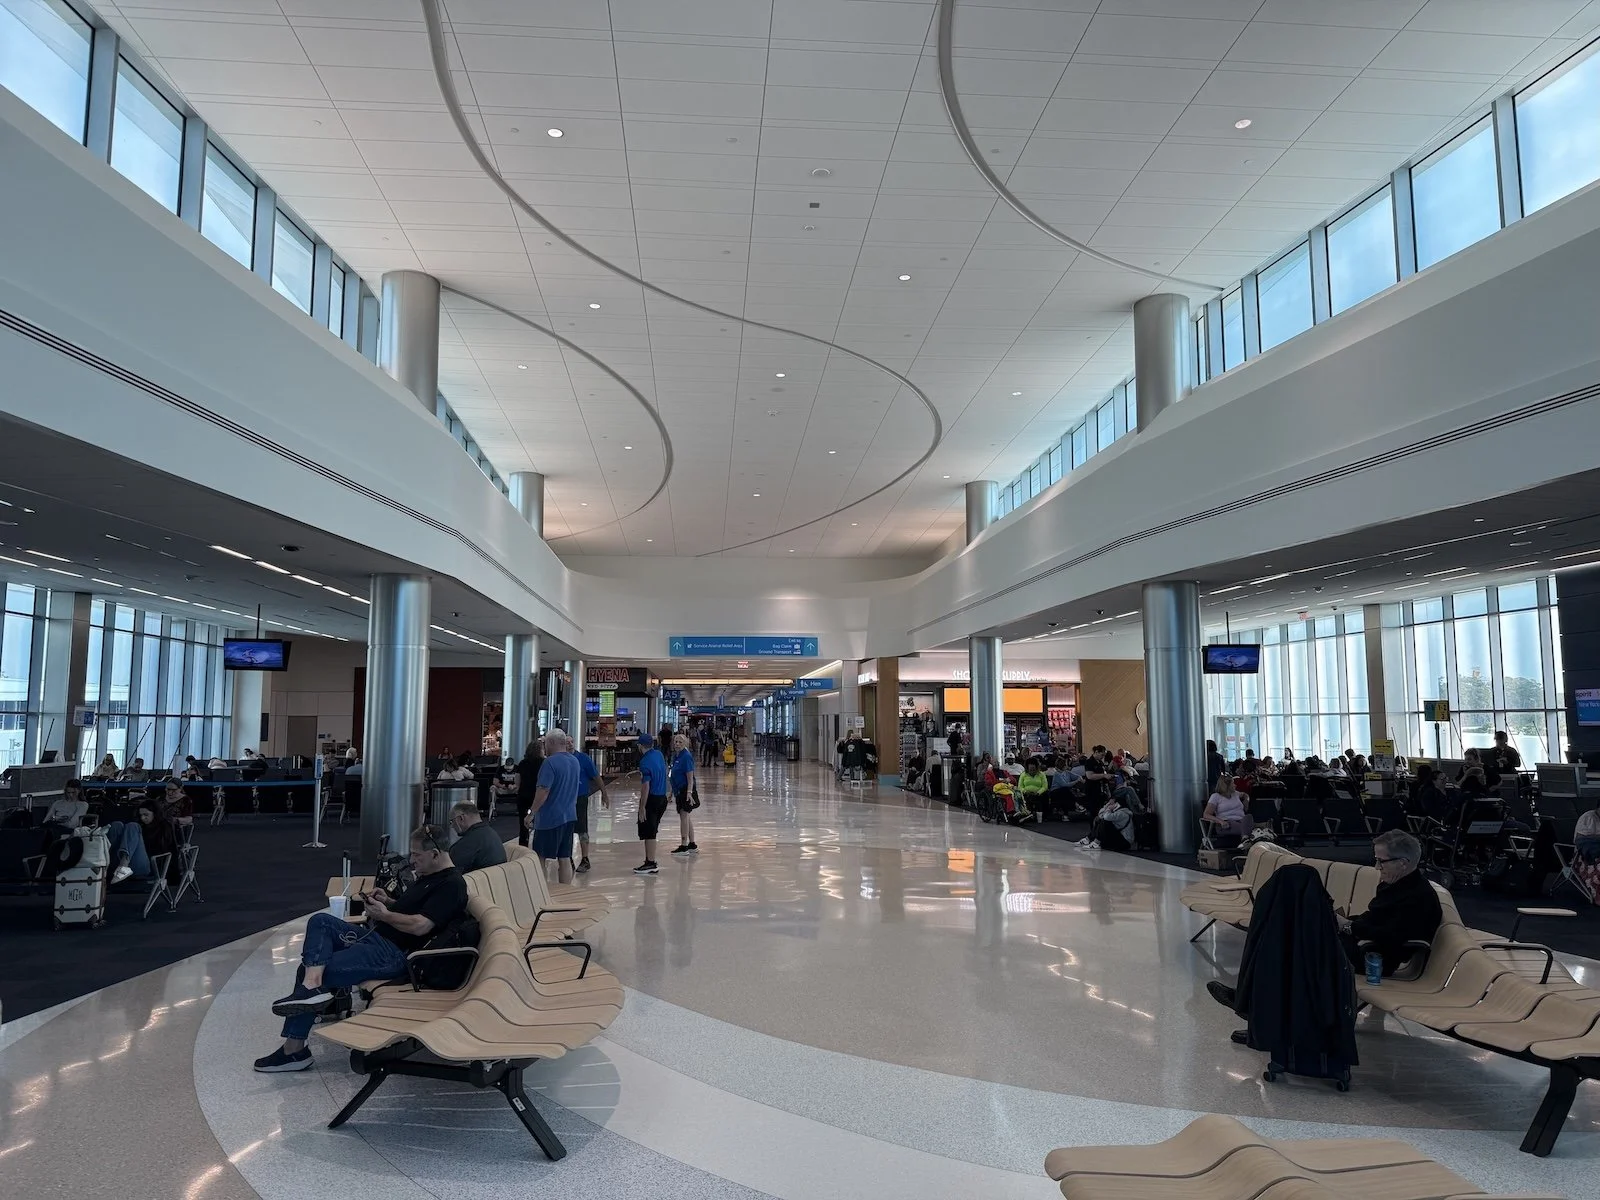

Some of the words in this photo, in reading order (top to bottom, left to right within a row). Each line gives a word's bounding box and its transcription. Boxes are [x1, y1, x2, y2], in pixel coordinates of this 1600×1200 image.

[588, 668, 630, 682] HYENA
[1002, 670, 1031, 681] SUPPLY
[664, 690, 678, 699] A5
[1575, 690, 1592, 698] spirit
